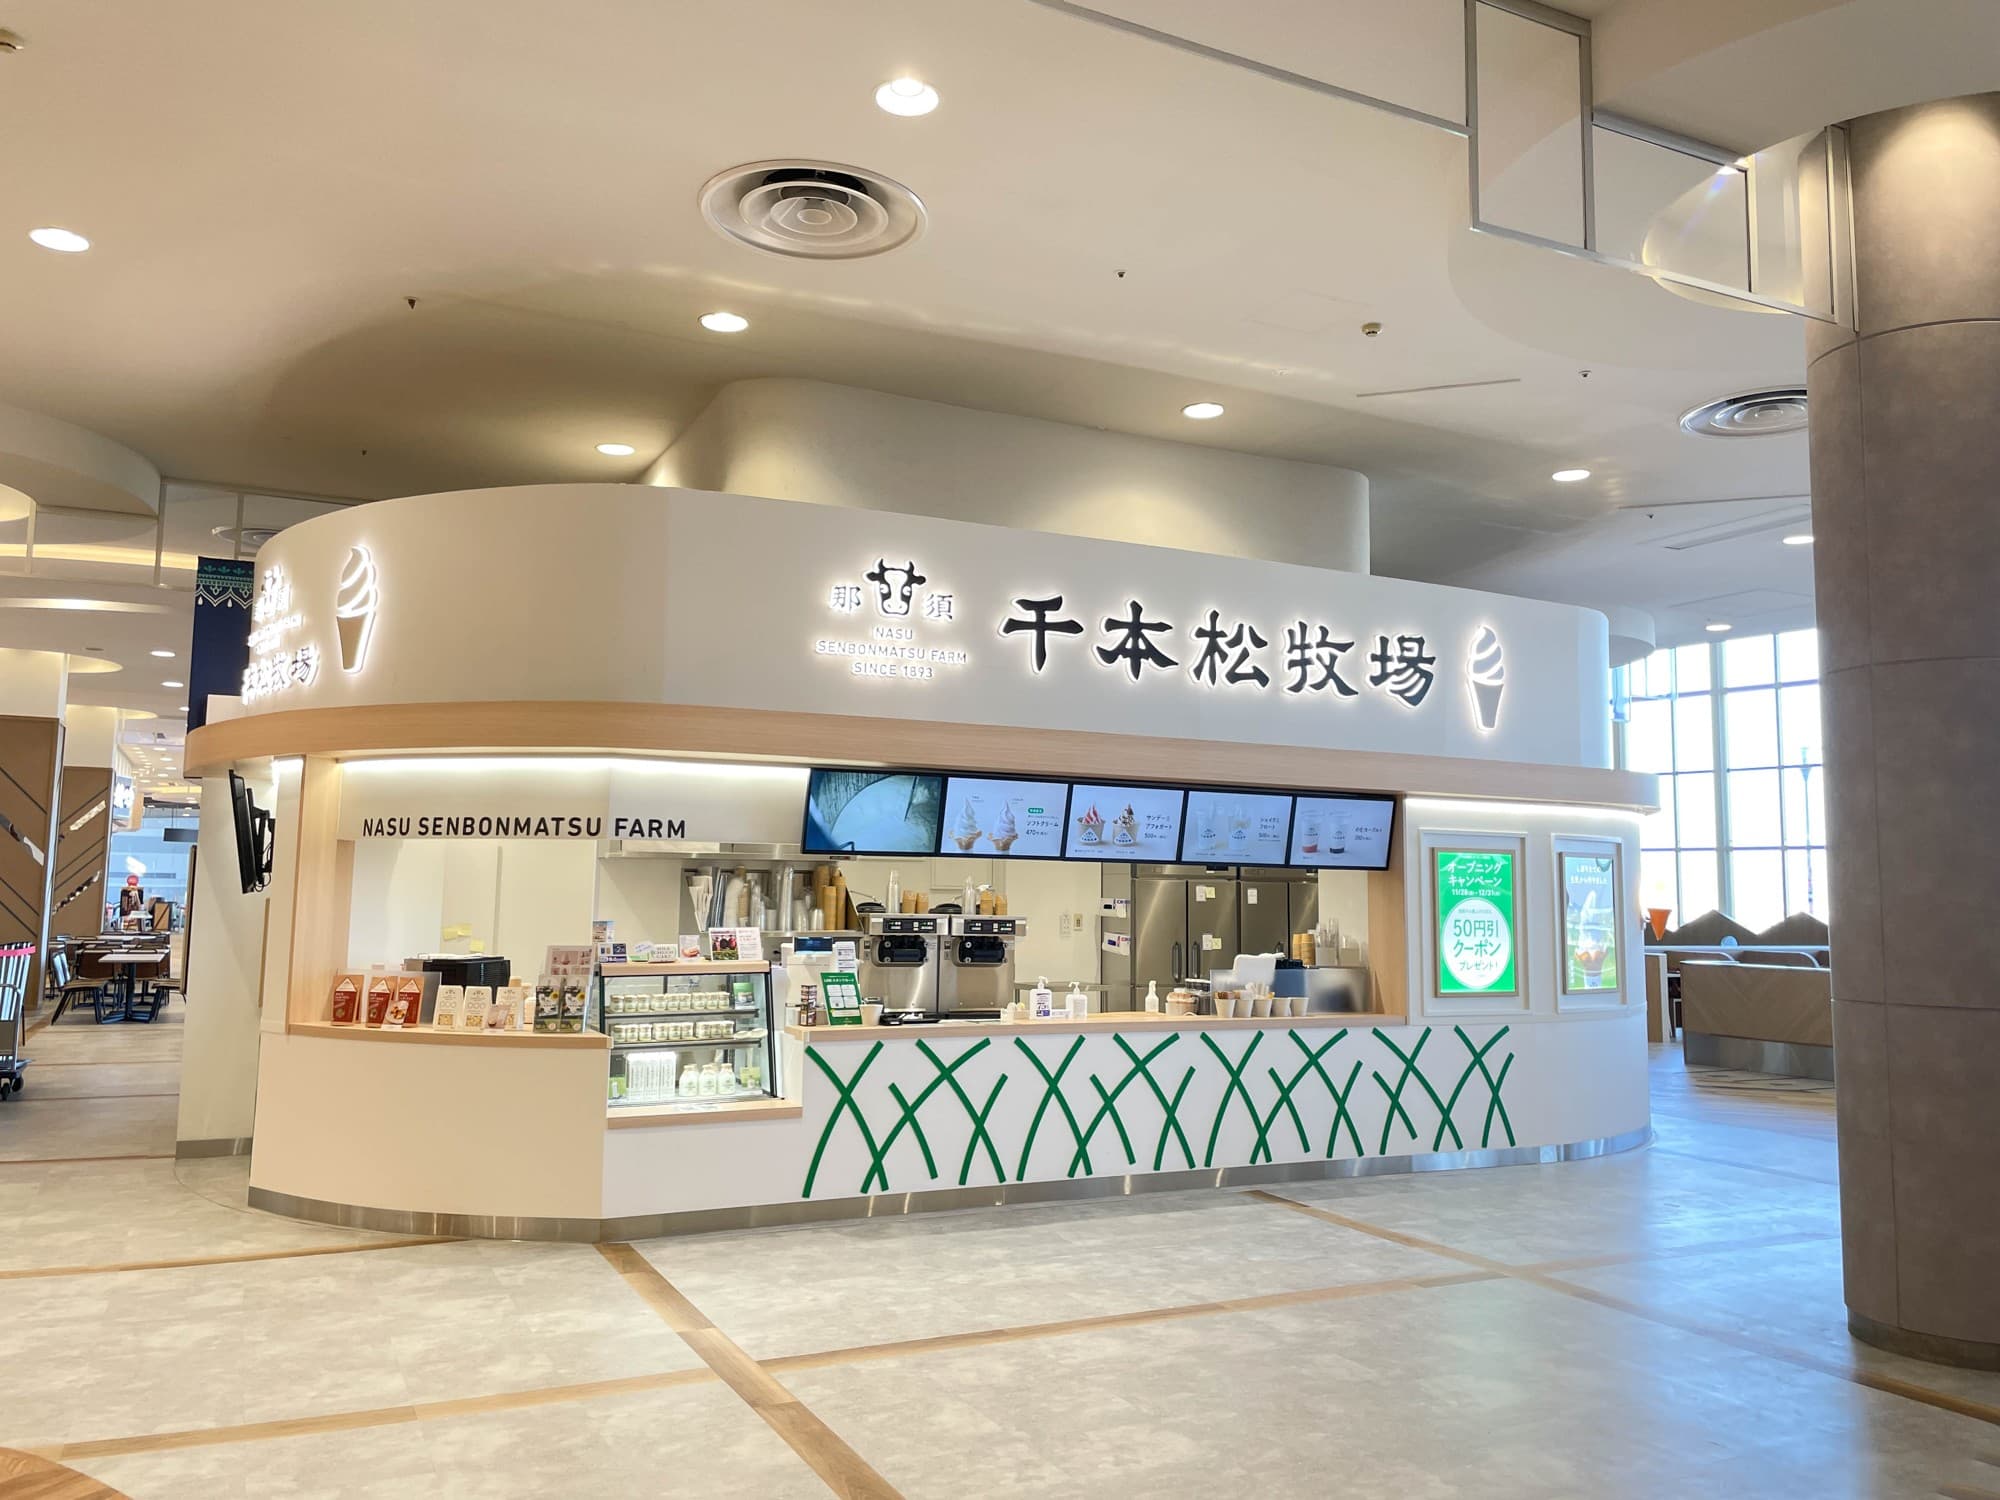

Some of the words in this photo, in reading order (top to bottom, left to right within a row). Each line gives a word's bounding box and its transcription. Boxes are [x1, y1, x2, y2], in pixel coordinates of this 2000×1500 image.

[874, 627, 914, 641] NASU
[817, 640, 926, 660] SENBONMATSU
[930, 650, 968, 664] FARM
[1001, 594, 1437, 707] 千本松牧場
[853, 662, 898, 676] SINCE
[903, 665, 934, 679] 1893
[362, 816, 411, 837] NASU
[417, 816, 602, 837] SENBONMATSU
[613, 817, 687, 839] FARM
[1447, 874, 1503, 887] キャンペーン
[1452, 919, 1499, 938] 50円引
[1453, 938, 1502, 958] クーポン
